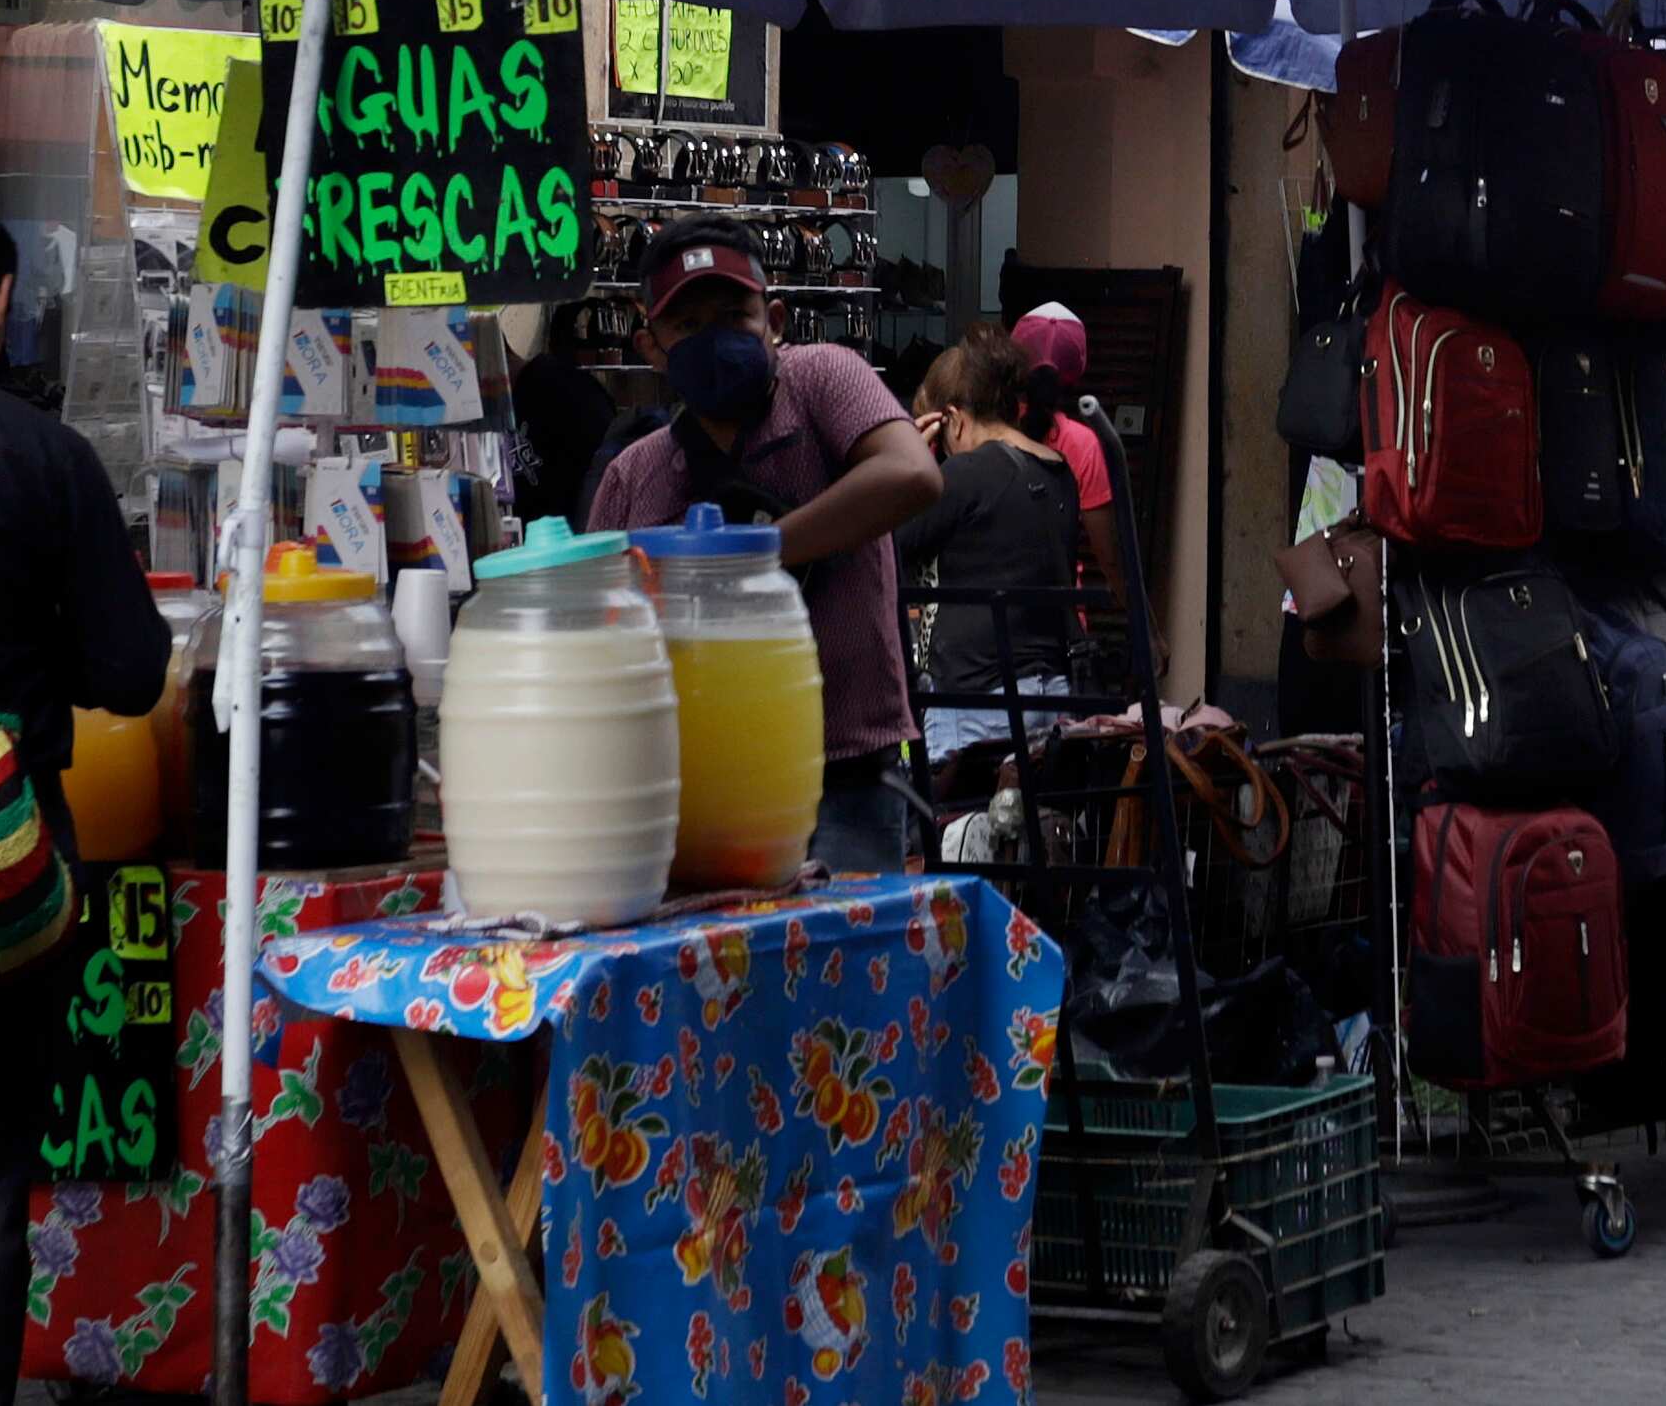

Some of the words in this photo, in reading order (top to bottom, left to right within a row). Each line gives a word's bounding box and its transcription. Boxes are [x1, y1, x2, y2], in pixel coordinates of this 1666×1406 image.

[619, 29, 637, 52] 2
[642, 28, 728, 54] CITURONES
[303, 165, 580, 282] RESCAS
